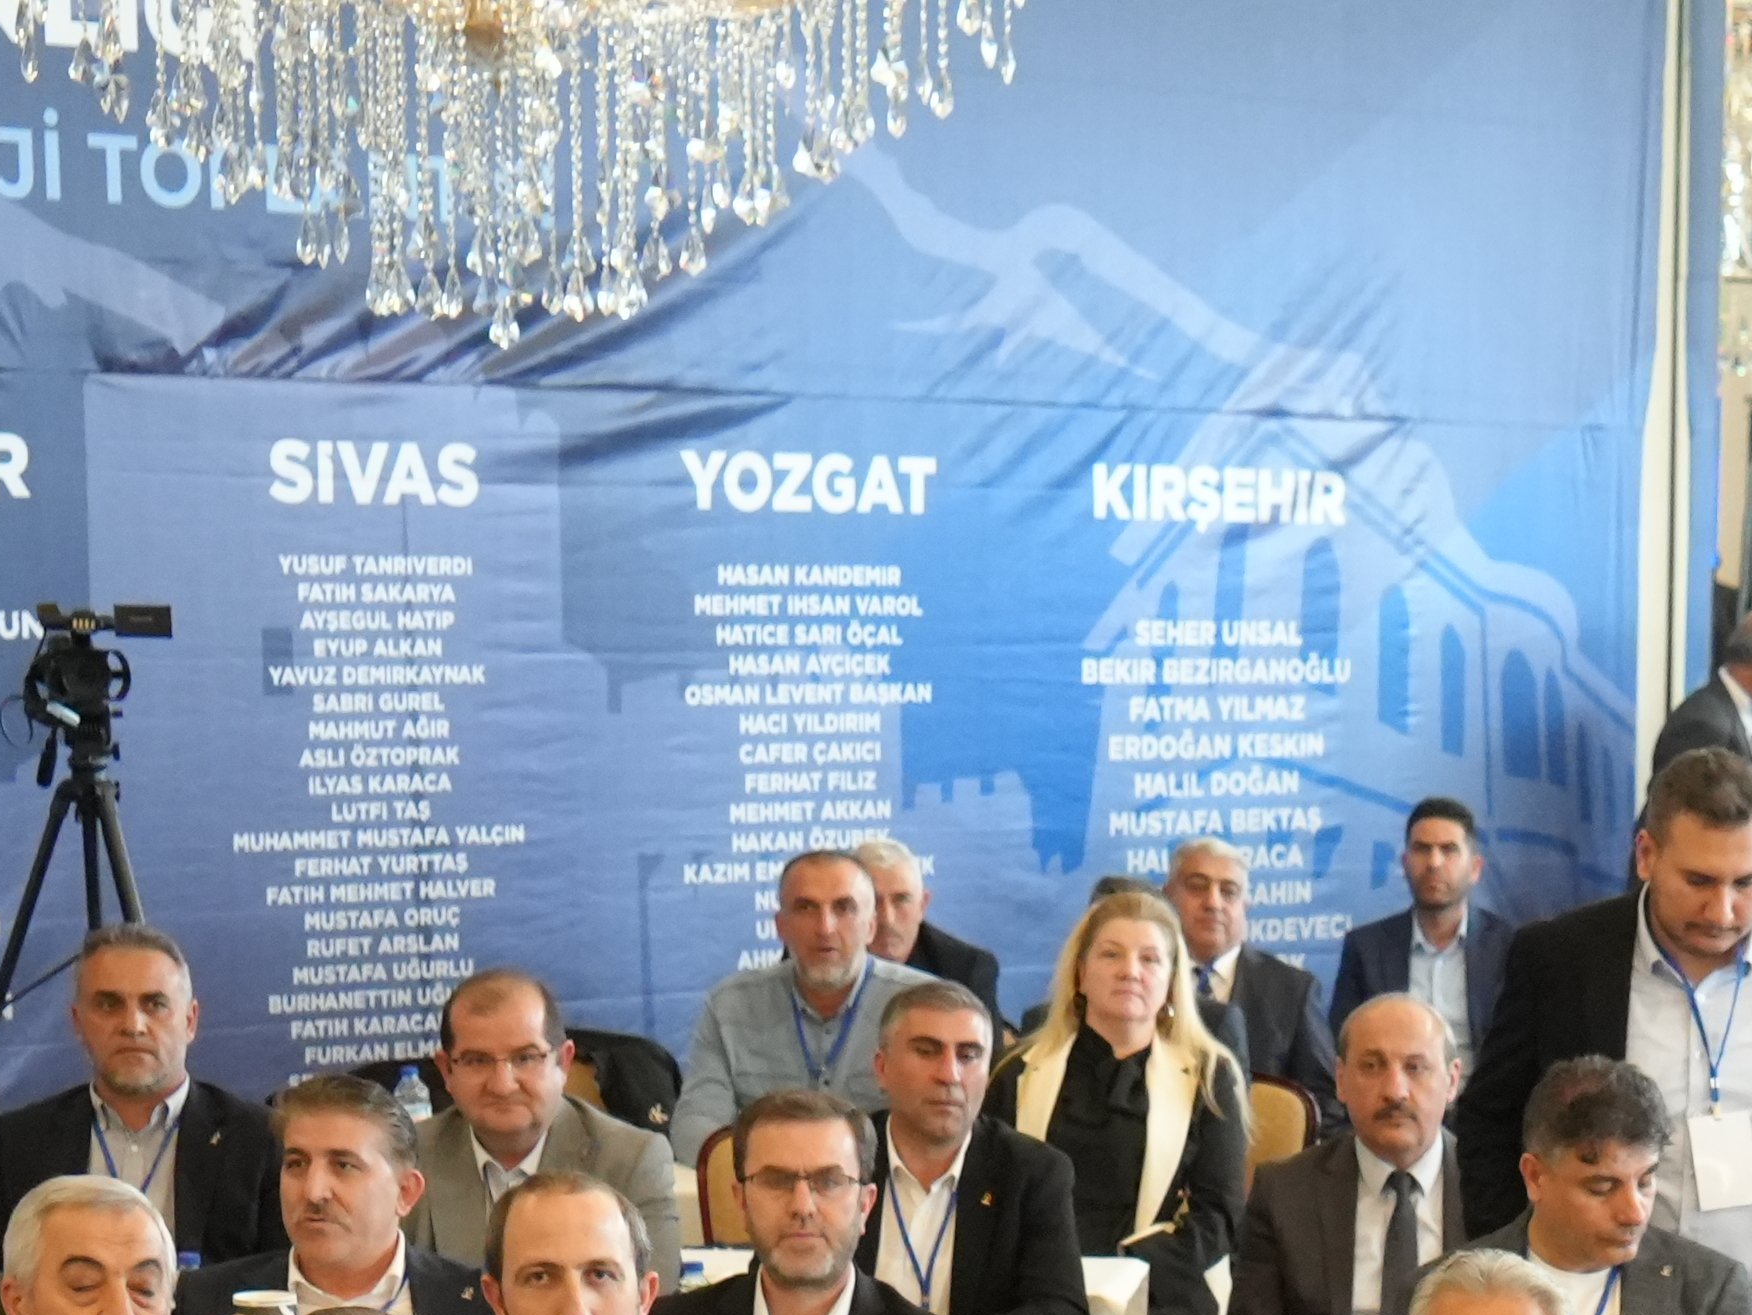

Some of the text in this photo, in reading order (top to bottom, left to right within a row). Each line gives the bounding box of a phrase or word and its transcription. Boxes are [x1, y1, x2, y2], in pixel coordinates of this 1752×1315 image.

[269, 438, 480, 508] SİVAS
[680, 449, 937, 515] YOZGAT
[278, 554, 347, 576] YUSUF
[717, 564, 790, 587] HASAN
[360, 582, 456, 604] SAKARYA
[694, 594, 783, 617] MEHMET
[855, 594, 923, 617] VAROL
[794, 624, 843, 647] SARI
[1135, 620, 1217, 646] SEHER
[373, 637, 443, 658] ALKAN
[268, 664, 338, 687] YAVUZ
[729, 653, 802, 676] HASAN
[684, 680, 932, 708] OSMAN LEVENT BAŞKAN
[1130, 695, 1306, 722] FATMA YILMAZ
[308, 714, 450, 741] MAHMUT AĞIR
[739, 711, 881, 735] HACI YILDIRIM
[299, 742, 460, 769] ASLI ÖZTOPRAK
[739, 742, 809, 765] CAFER
[1108, 730, 1231, 760] ERDOĞAN
[368, 772, 452, 794] KARACA
[744, 771, 823, 794] FERHAT
[1210, 767, 1299, 797] DOĞAN
[392, 800, 431, 822] TAŞ
[729, 799, 892, 824] MEHMET AKKAN
[1109, 811, 1222, 837] MUSTAFA
[232, 829, 352, 853] MUHAMMET
[356, 825, 451, 849] MUSTAFA
[731, 830, 805, 853] HAKAN
[294, 855, 373, 878] FERHAT
[683, 862, 751, 885] KAZIM
[329, 880, 415, 903] MEHMET
[304, 908, 399, 932] MUSTAFA
[377, 932, 460, 955] ARSLAN
[292, 962, 388, 986] MUSTAFA
[304, 1041, 390, 1066] FURKAN
